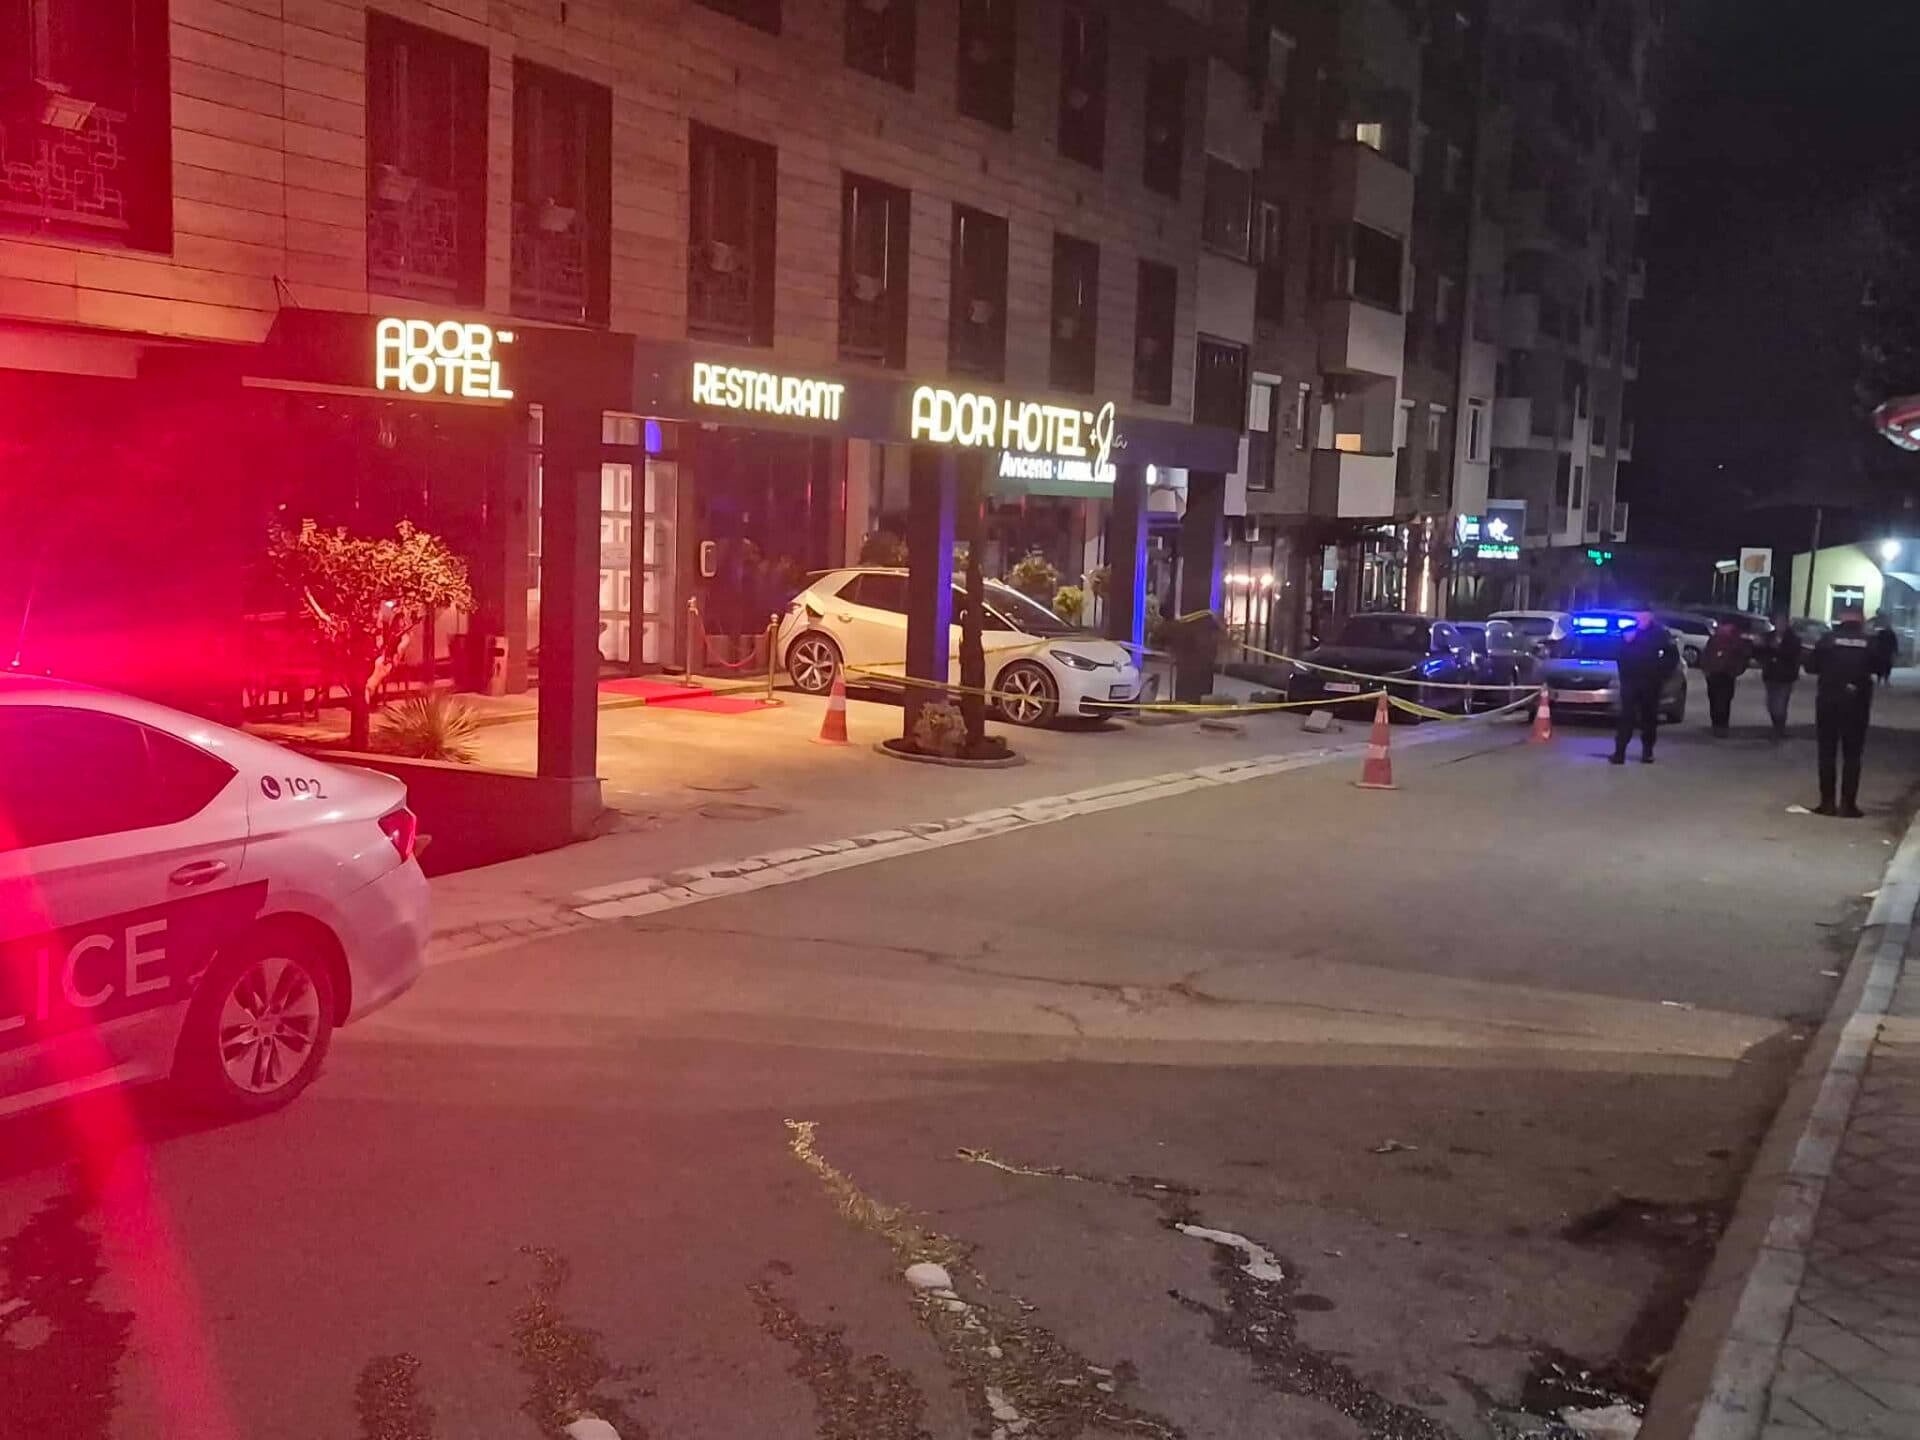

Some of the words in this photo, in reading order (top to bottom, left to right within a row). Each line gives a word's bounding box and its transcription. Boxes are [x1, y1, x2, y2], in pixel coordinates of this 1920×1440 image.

[376, 318, 493, 363] ADOR
[376, 354, 514, 399] HOTEL
[692, 362, 845, 420] RESTAURANT
[911, 386, 997, 448] ADOR
[1002, 399, 1086, 456] HOTEL
[999, 451, 1053, 480] Avicena
[284, 777, 328, 799] 192
